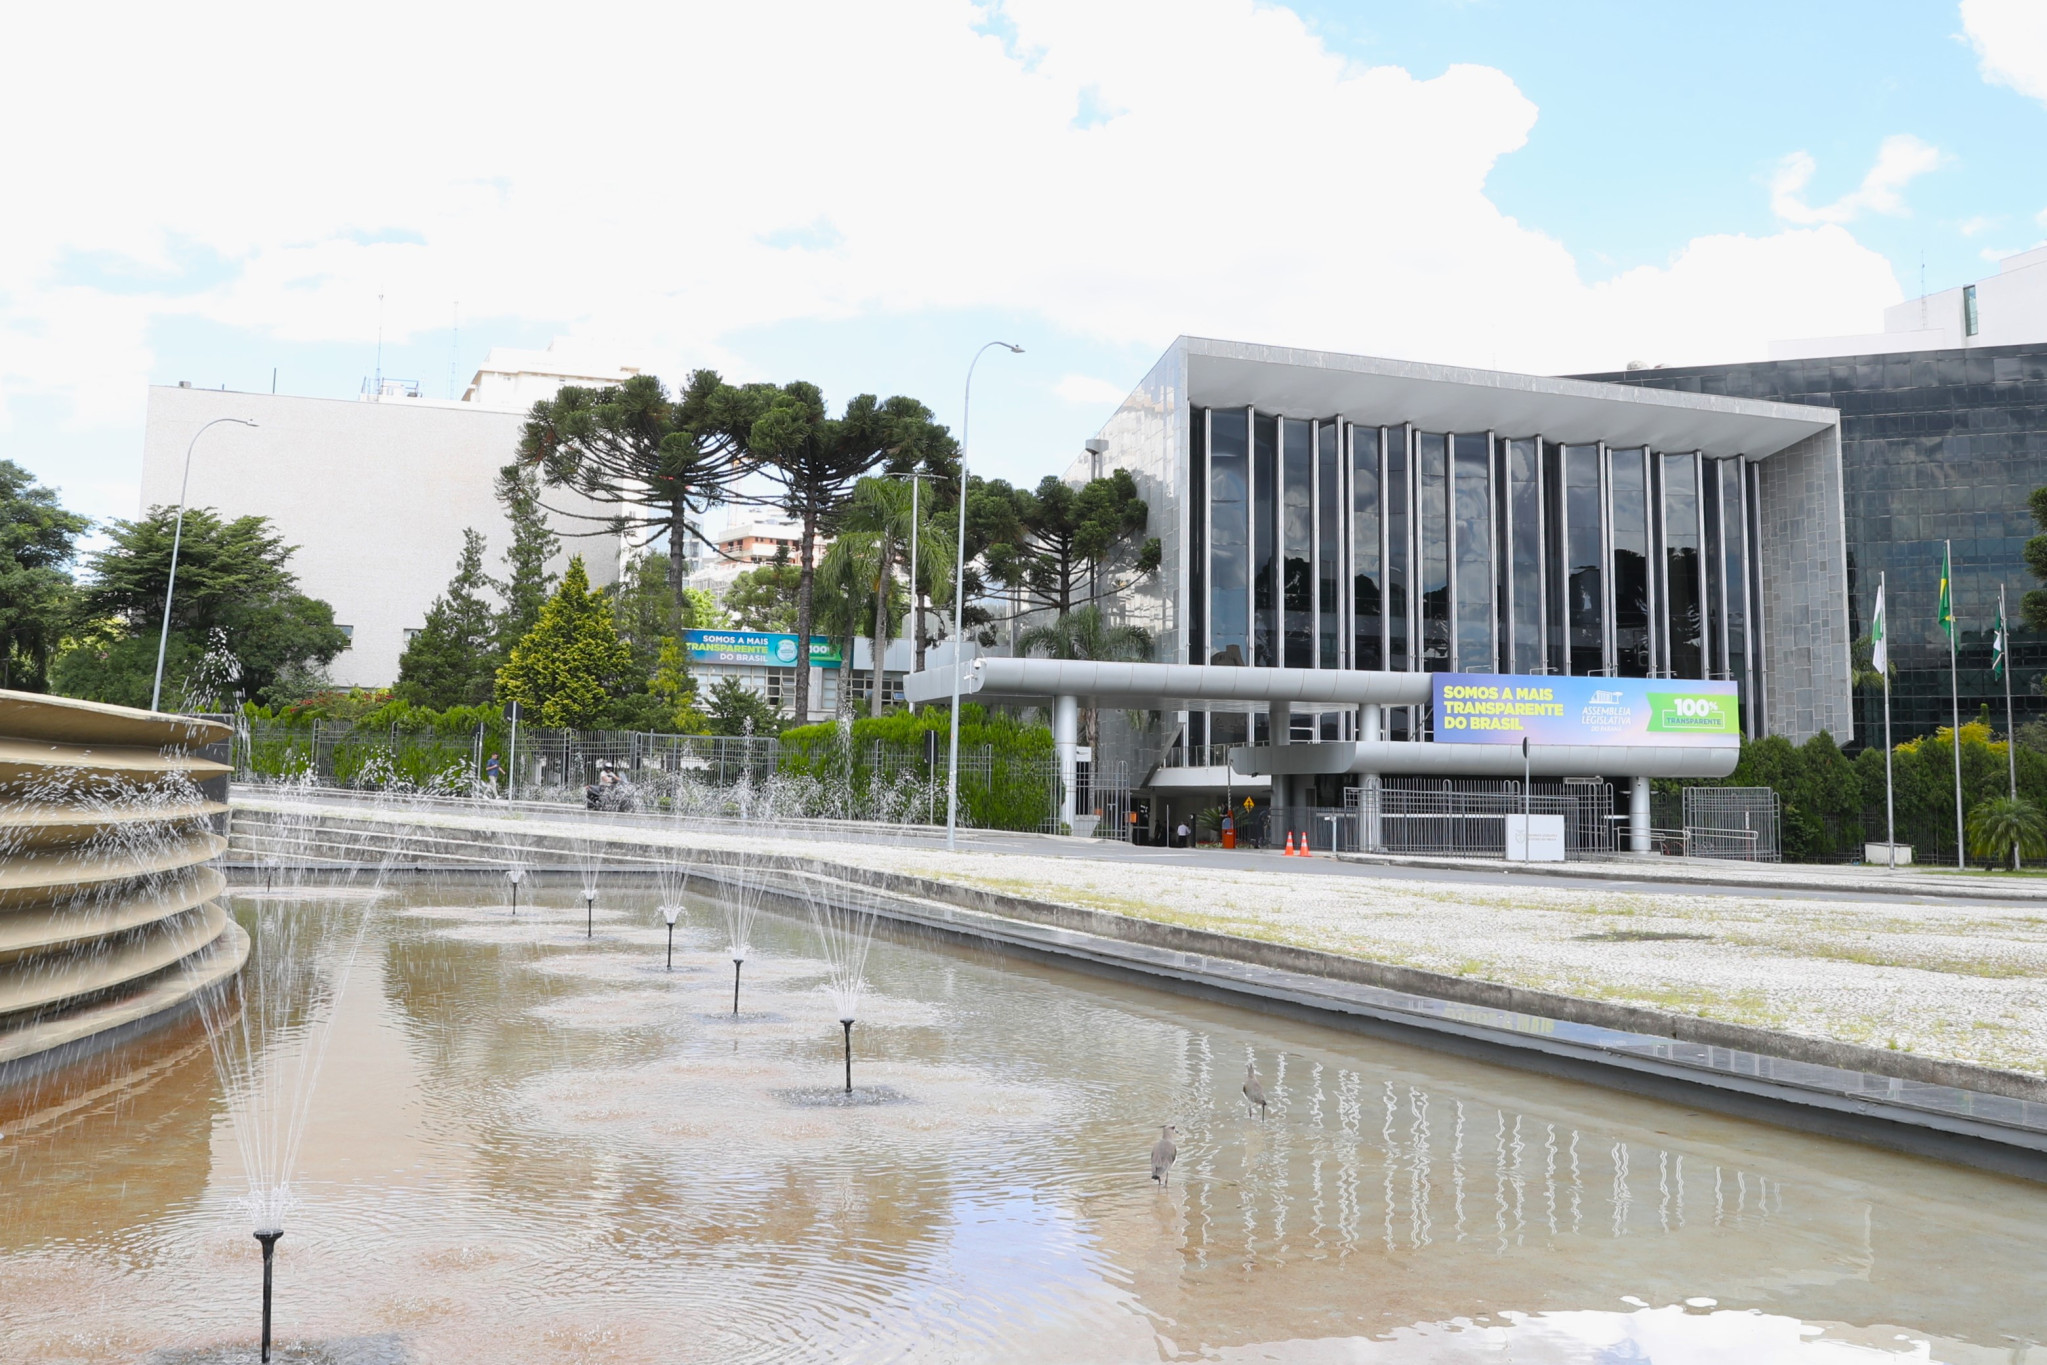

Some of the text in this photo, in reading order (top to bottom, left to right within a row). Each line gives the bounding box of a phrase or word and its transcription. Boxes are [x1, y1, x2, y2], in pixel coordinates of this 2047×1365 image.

[703, 635, 735, 644] SOMOS
[686, 643, 768, 653] TRANSPARENTE
[736, 654, 768, 662] BRASIL
[1443, 686, 1554, 701] SOMOS A MAIS
[1443, 701, 1565, 716] TRANSPARENTE
[1581, 706, 1632, 716] ASSEMBLEIA
[1674, 698, 1719, 717] 100%
[1444, 716, 1524, 730] DO BRASIL
[1581, 716, 1632, 725] LEGISLATIVA
[1666, 717, 1722, 726] TRANSPARENTE
